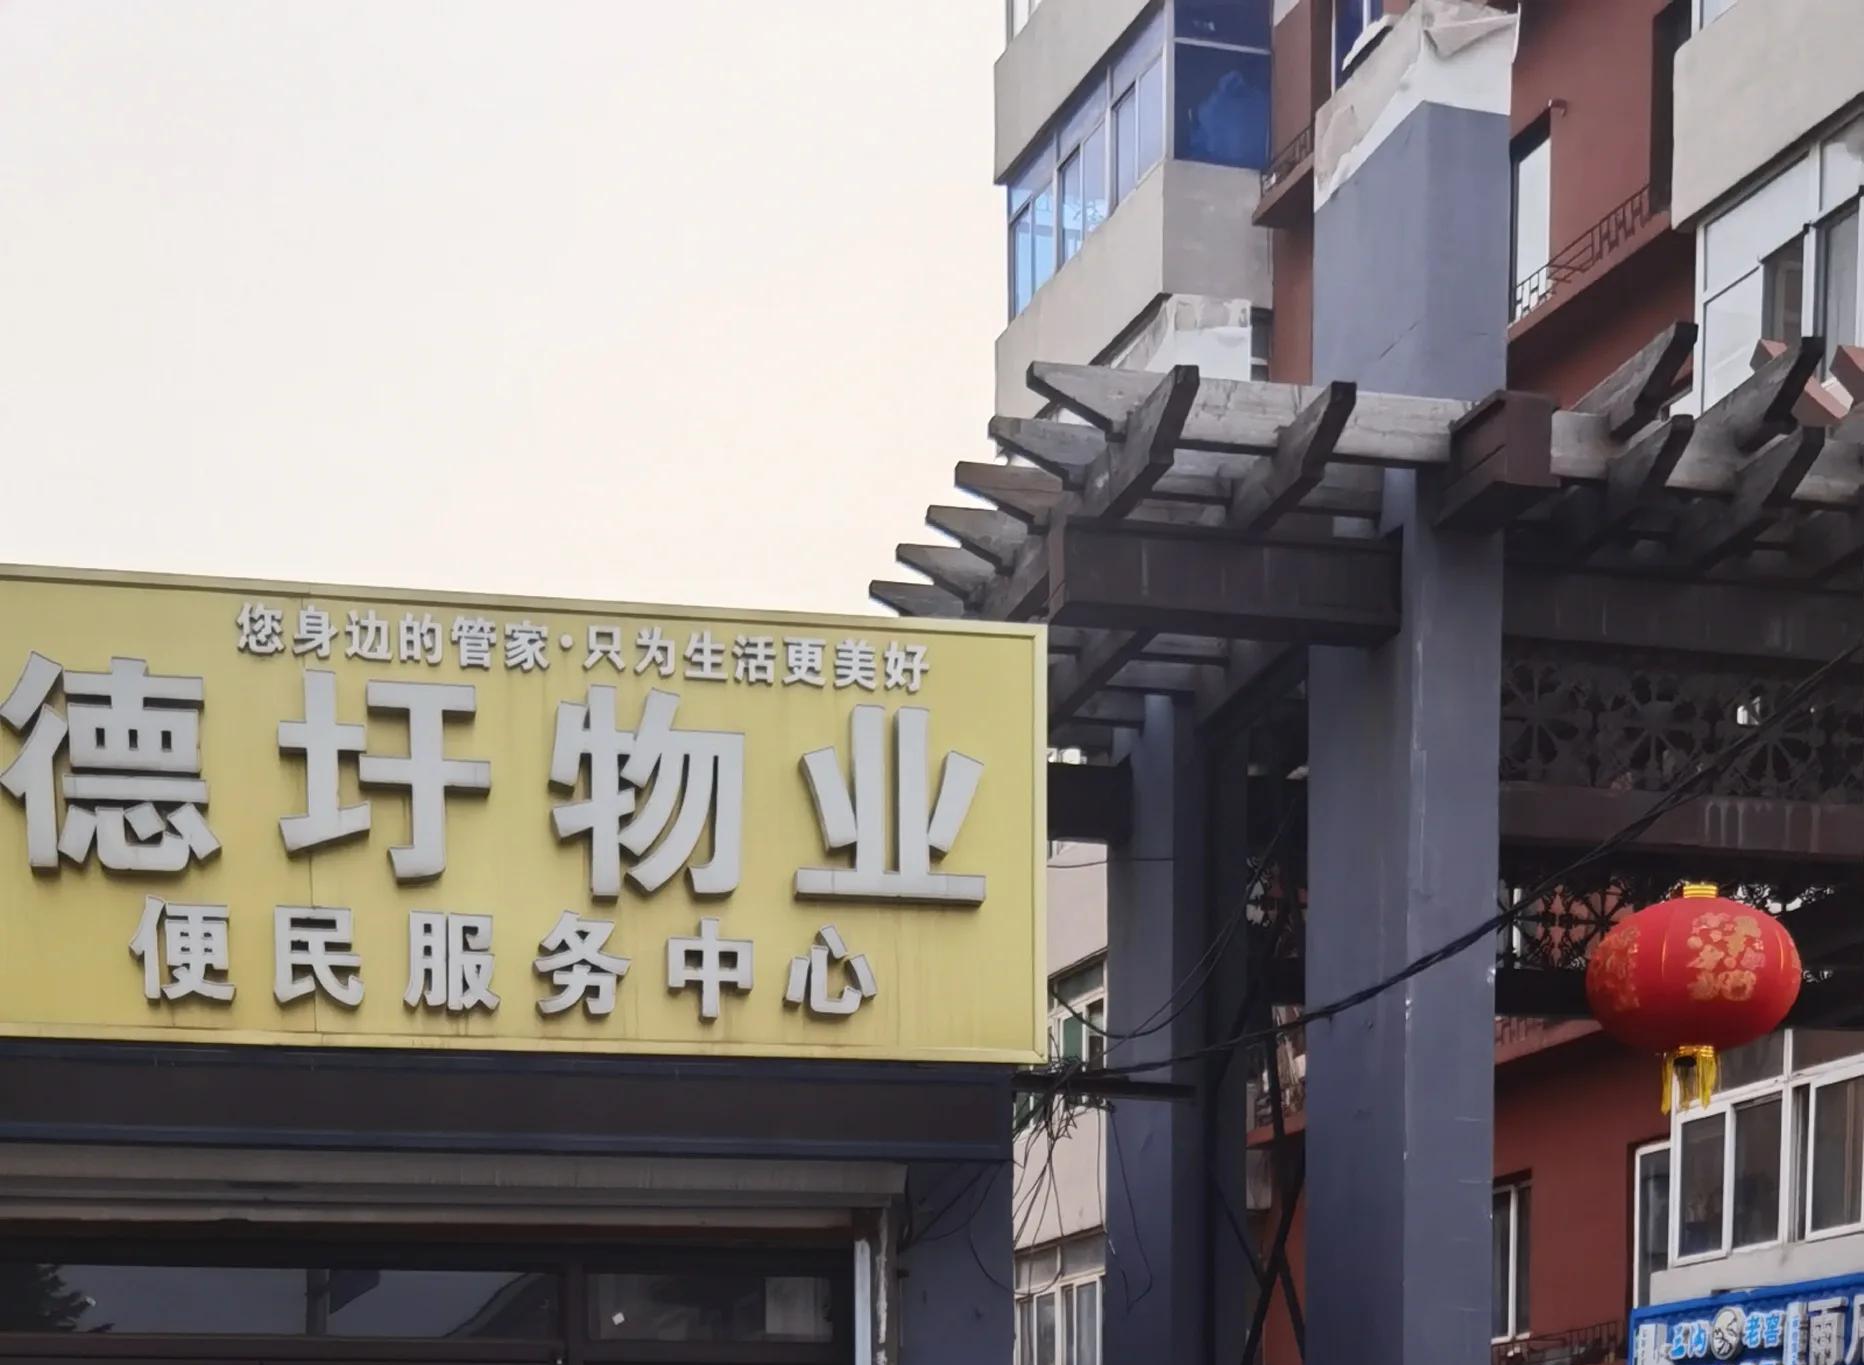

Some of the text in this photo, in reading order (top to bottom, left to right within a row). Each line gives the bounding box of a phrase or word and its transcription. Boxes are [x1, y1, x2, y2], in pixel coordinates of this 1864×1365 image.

[237, 603, 930, 695] 您身边的管家·只为生活更美好
[0, 651, 986, 906] 德圩物业
[129, 896, 877, 1021] 便民服务中心
